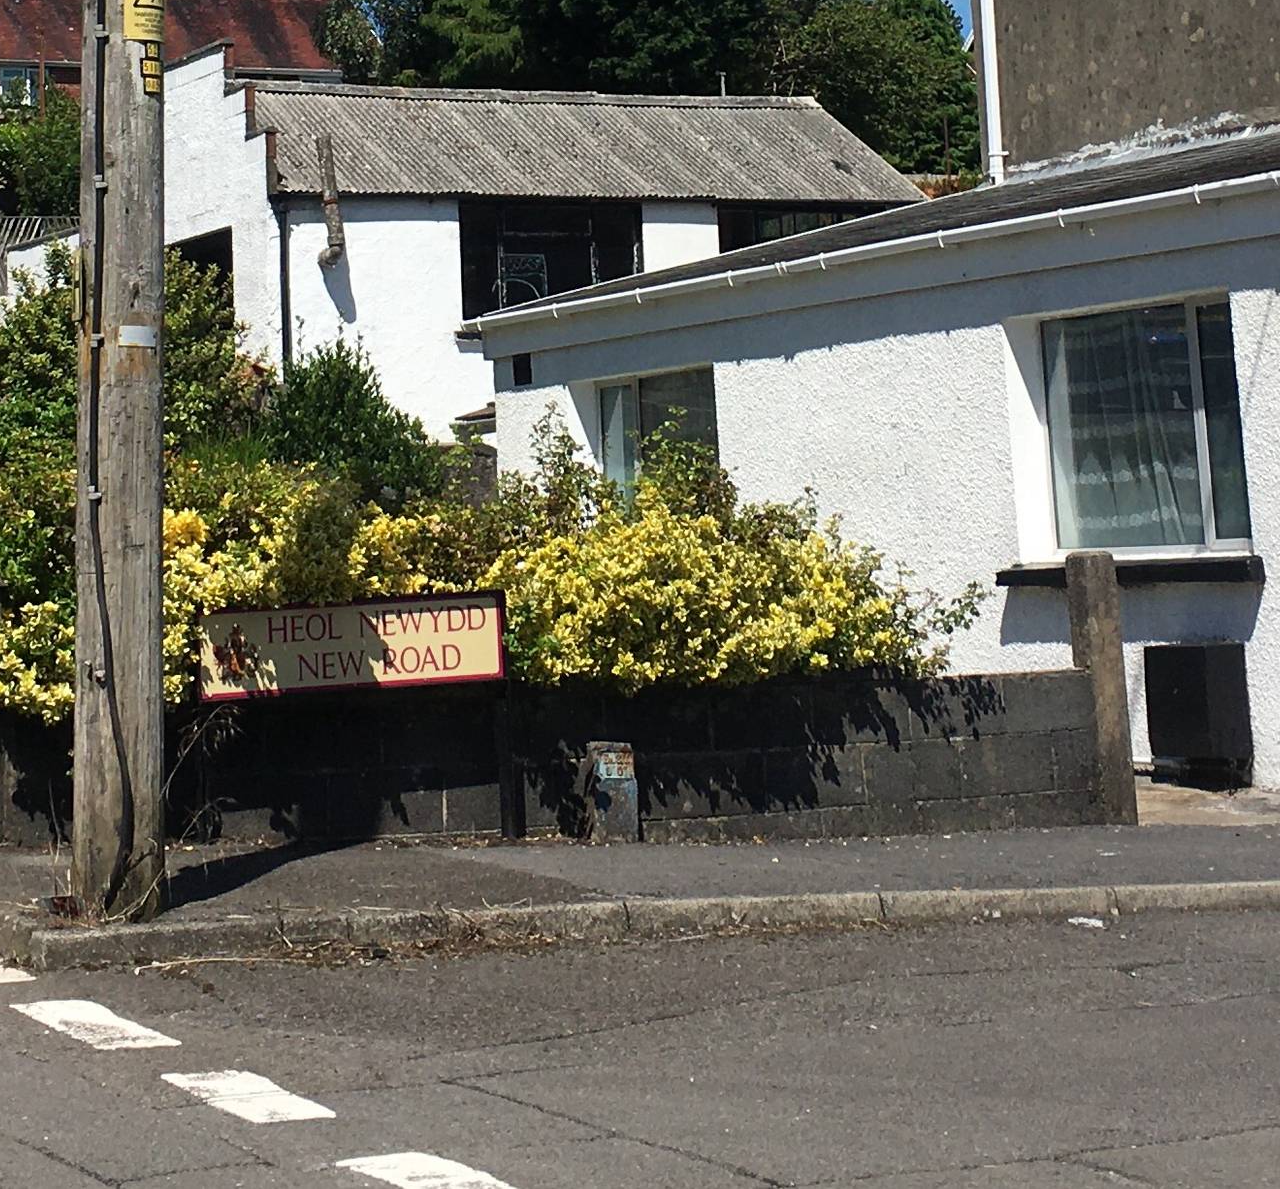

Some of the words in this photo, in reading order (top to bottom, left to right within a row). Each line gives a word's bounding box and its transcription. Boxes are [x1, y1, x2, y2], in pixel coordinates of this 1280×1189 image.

[267, 613, 342, 644] HEOL
[359, 604, 487, 638] NEWYDD
[298, 650, 365, 681] NEW
[382, 644, 461, 675] ROAD
